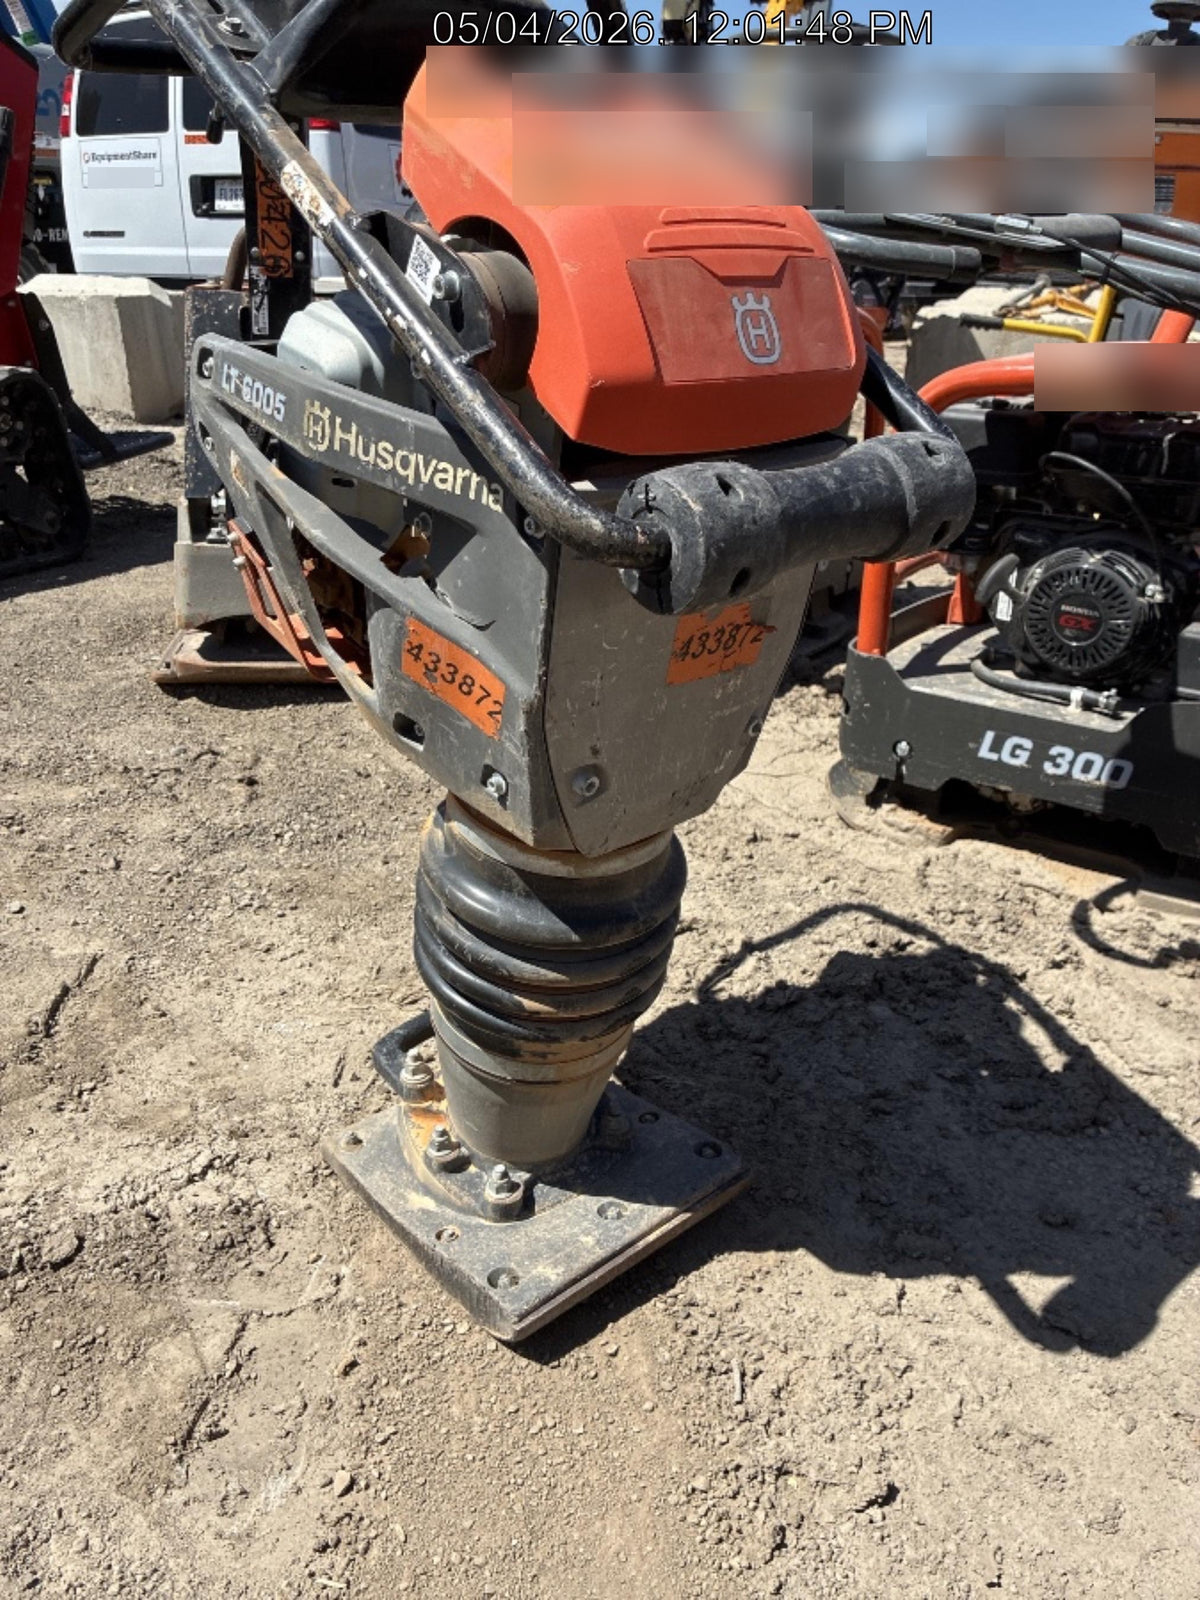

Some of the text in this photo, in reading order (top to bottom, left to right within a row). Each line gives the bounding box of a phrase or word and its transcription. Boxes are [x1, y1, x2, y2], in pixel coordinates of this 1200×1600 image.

[221, 362, 287, 423] LT 6005
[333, 416, 504, 513] Husqvarna
[672, 620, 764, 662] 433872
[1058, 613, 1097, 631] GX
[406, 640, 503, 721] 433872
[977, 730, 1134, 790] LG 300
